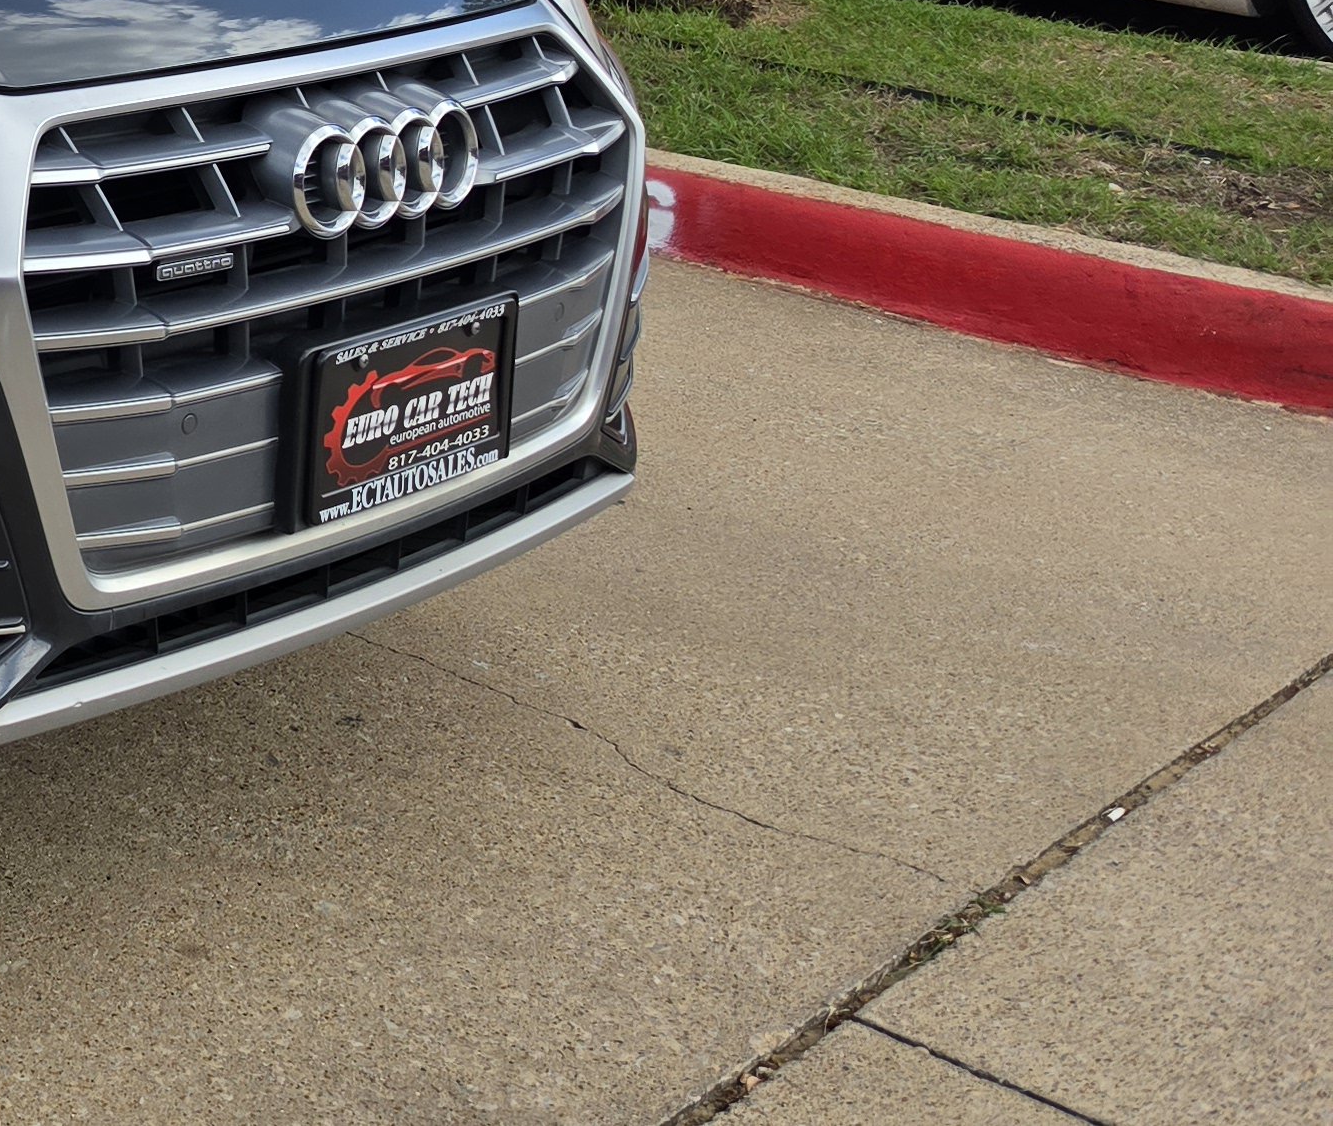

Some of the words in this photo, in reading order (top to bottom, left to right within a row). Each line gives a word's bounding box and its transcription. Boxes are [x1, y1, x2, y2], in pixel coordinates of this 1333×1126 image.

[161, 257, 232, 278] quattro
[335, 348, 368, 365] SALES
[368, 343, 379, 354] &
[379, 328, 428, 351] SERVICE
[437, 304, 506, 334] 817-404-4033
[342, 405, 400, 449] EURO
[404, 390, 443, 430] CAR
[446, 372, 495, 415] TECH
[389, 422, 436, 446] european
[437, 402, 491, 429] automotive
[387, 425, 490, 470] 817-404-4033
[319, 447, 499, 523] www.ECTAUTOSALES.com
